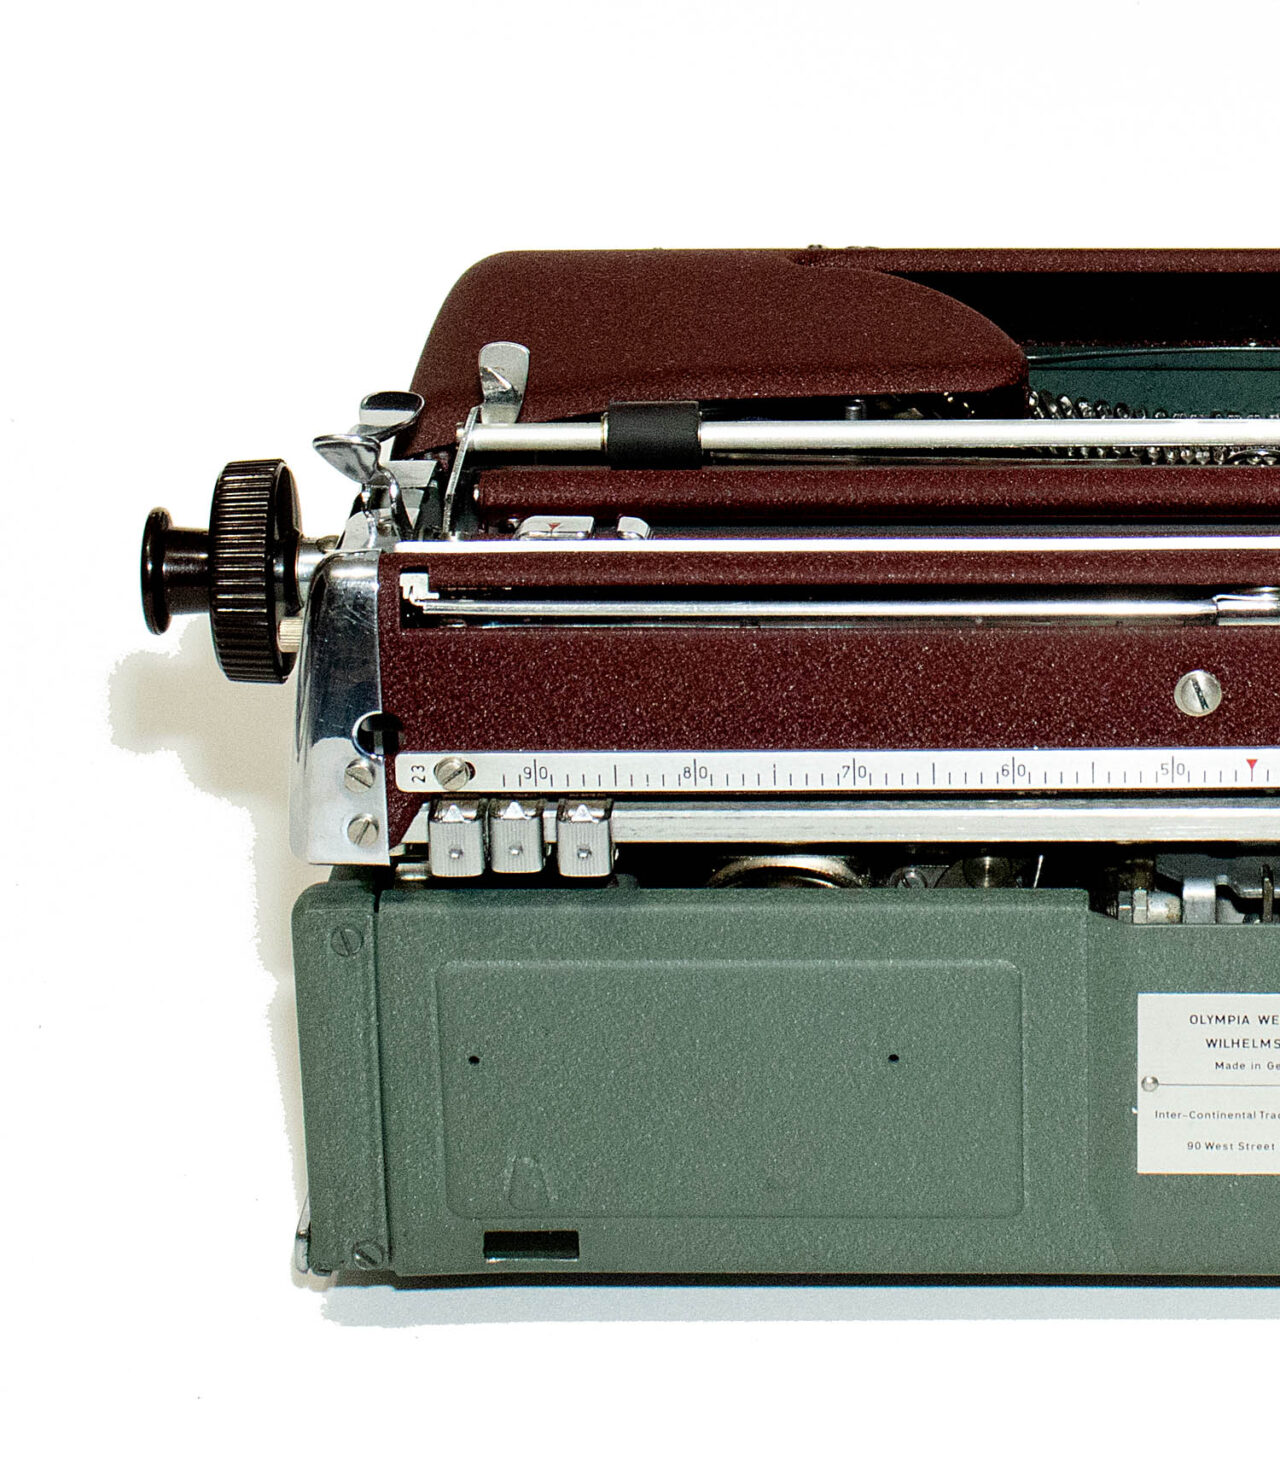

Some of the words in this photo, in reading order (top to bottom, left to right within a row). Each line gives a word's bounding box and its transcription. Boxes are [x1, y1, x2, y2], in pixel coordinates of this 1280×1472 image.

[411, 764, 426, 783] 23
[523, 766, 548, 780] 90
[682, 766, 708, 779] 80
[842, 765, 867, 778] 70
[1001, 763, 1026, 777] 60
[1160, 762, 1186, 776] 50
[1189, 1014, 1250, 1026] OLYMPIA
[1215, 1061, 1246, 1071] Made
[1250, 1061, 1261, 1071] in
[1154, 1110, 1257, 1121] Inter-Continental
[1187, 1141, 1202, 1151] 90
[1204, 1141, 1234, 1151] West
[1238, 1141, 1275, 1151] Street
